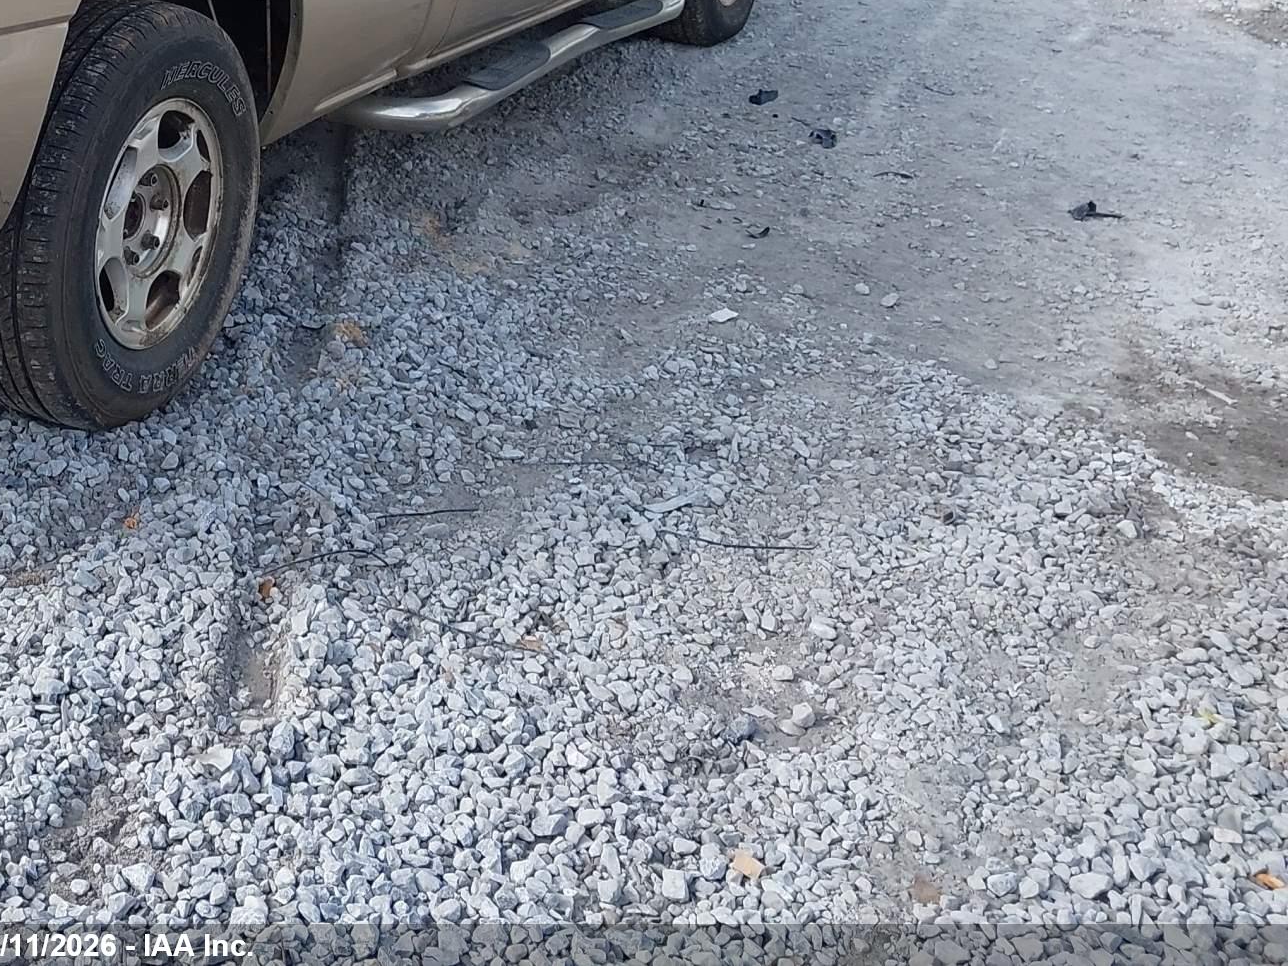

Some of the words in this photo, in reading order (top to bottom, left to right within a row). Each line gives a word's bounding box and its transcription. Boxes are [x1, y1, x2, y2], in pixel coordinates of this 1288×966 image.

[160, 60, 247, 117] HERCULES
[95, 338, 133, 392] TRAC
[139, 345, 196, 394] TERRA
